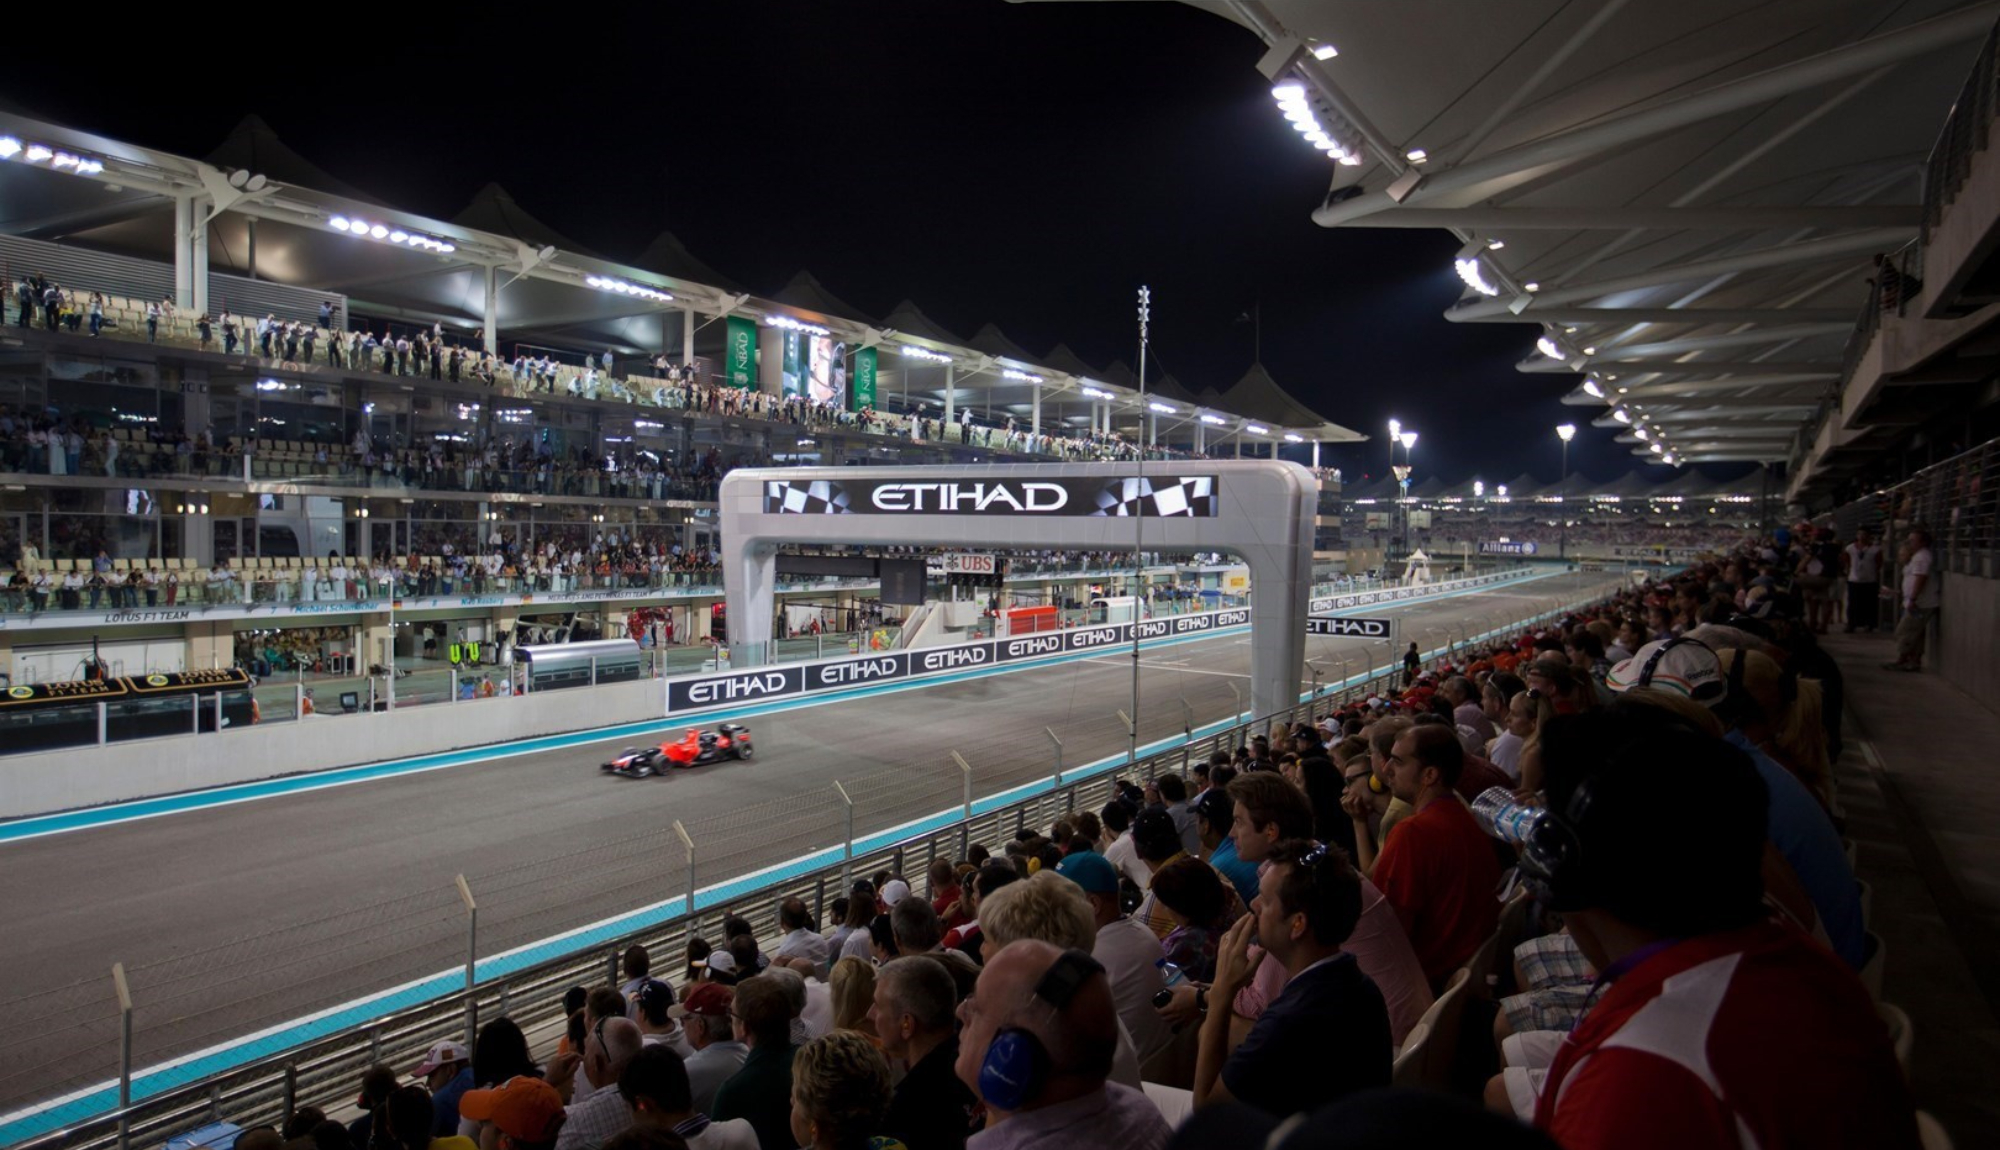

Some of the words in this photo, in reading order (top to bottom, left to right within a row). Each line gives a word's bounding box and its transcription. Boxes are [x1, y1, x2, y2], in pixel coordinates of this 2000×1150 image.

[738, 331, 749, 370] NBAD
[871, 482, 1068, 511] ETIHAD
[1482, 542, 1520, 553] Allianz
[961, 555, 992, 572] UBS
[105, 612, 141, 623] LOTUS
[144, 612, 158, 621] F1
[160, 611, 190, 620] TEAM
[1177, 616, 1210, 631] ETIHAD
[1217, 611, 1247, 625] ETIHAD
[1072, 628, 1115, 647] ETIHAD
[1129, 622, 1166, 639] ETIHAD
[1008, 636, 1060, 657] ETIHAD
[924, 647, 986, 670] ETIHAD
[820, 657, 898, 684] ETIHAD
[688, 672, 786, 703] ETIHAD
